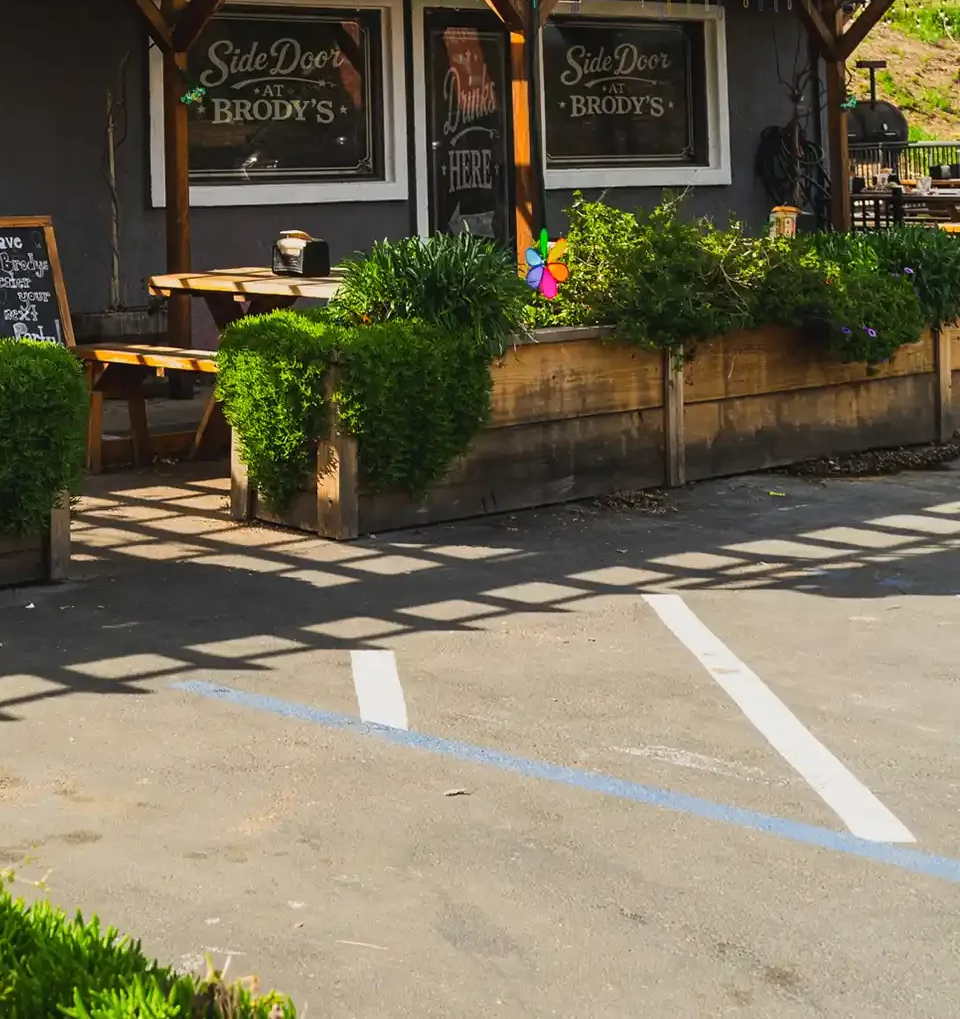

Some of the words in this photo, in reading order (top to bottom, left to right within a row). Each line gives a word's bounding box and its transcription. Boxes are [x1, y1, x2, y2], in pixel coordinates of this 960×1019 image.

[200, 40, 269, 87] Side
[270, 37, 346, 75] Door
[560, 45, 613, 86] Side
[613, 43, 672, 75] Door
[262, 84, 284, 97] AT
[443, 61, 497, 136] Drinks
[608, 83, 625, 94] AT
[211, 98, 335, 124] BRODY'S
[570, 94, 665, 117] BRODY'S
[448, 149, 493, 193] HERE
[3, 303, 39, 322] next
[17, 291, 51, 310] your
